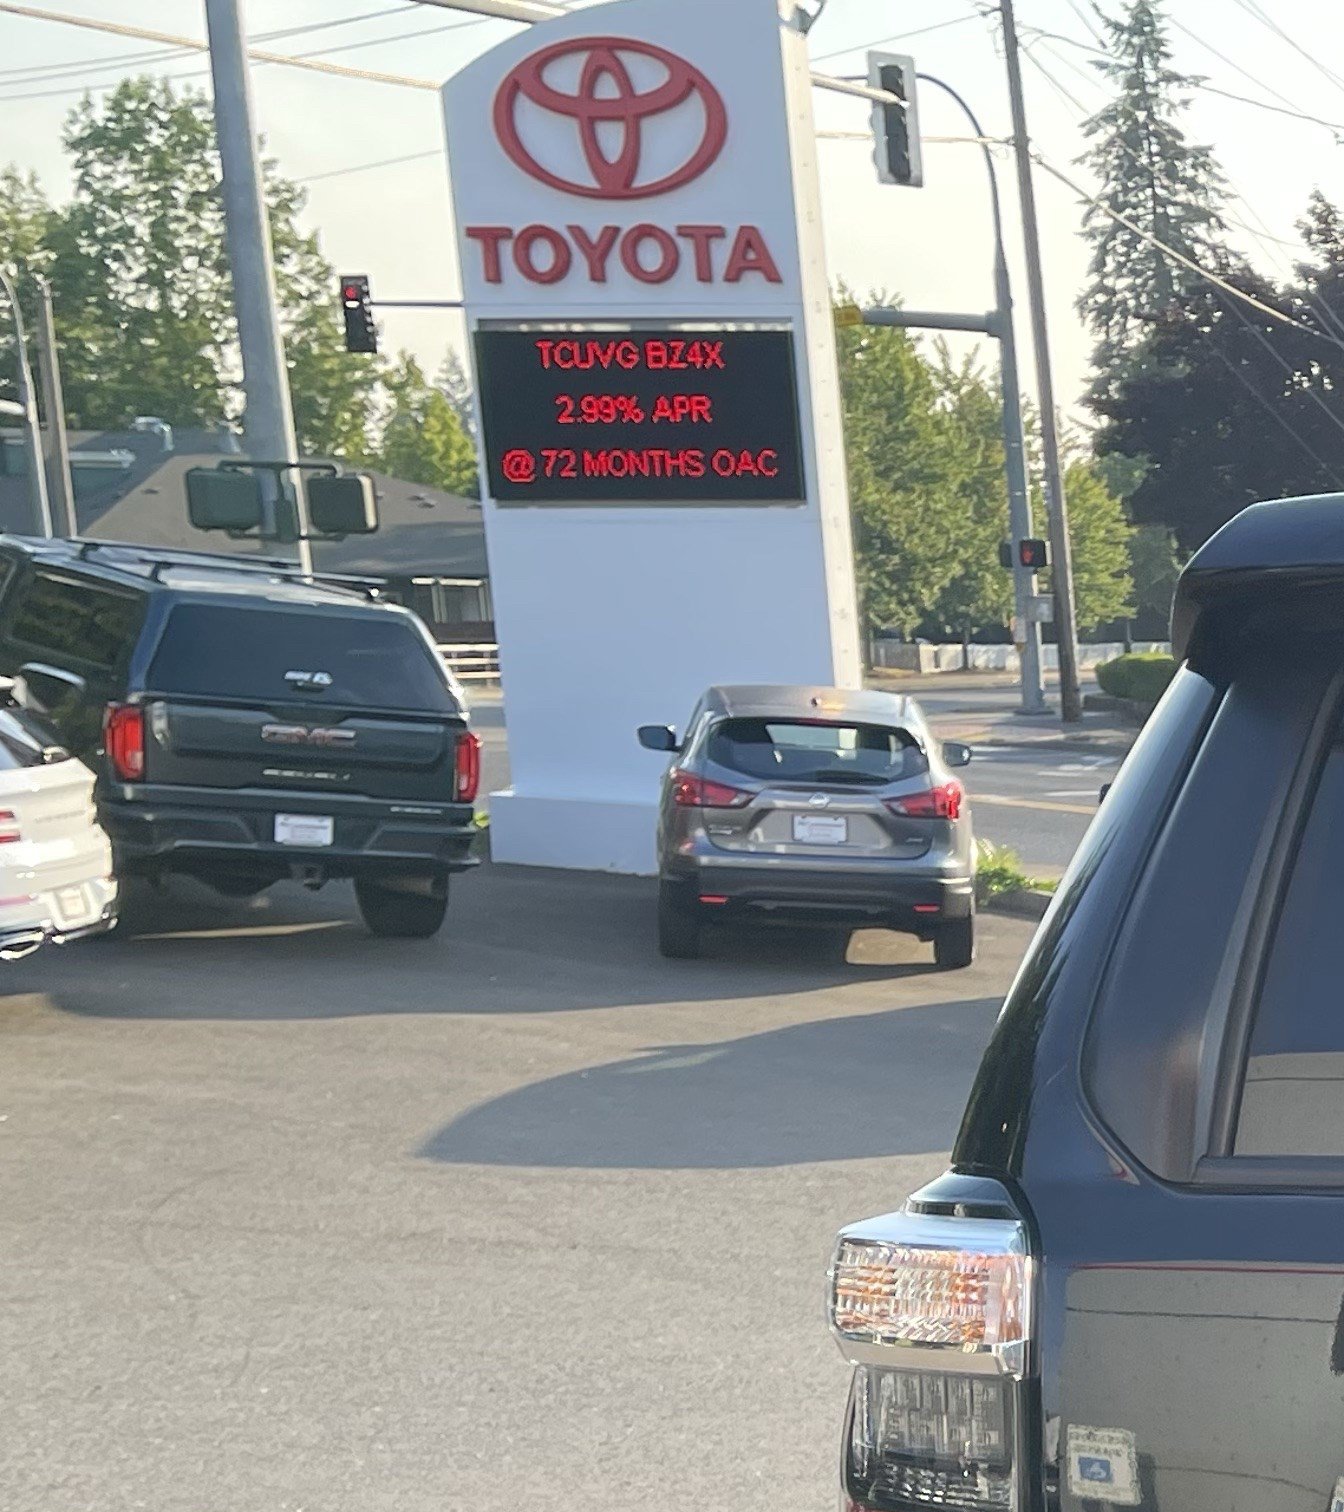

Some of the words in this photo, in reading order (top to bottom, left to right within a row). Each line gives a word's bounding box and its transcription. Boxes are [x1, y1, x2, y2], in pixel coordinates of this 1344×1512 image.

[465, 223, 783, 284] TOYOTA
[535, 340, 640, 370] TCUVG
[645, 340, 726, 370] BZ4X
[555, 395, 645, 424] 2.99%
[652, 395, 713, 424] APR
[502, 449, 536, 483] @
[540, 449, 578, 478] 72
[582, 449, 706, 478] MONTHS
[711, 449, 779, 478] OAC
